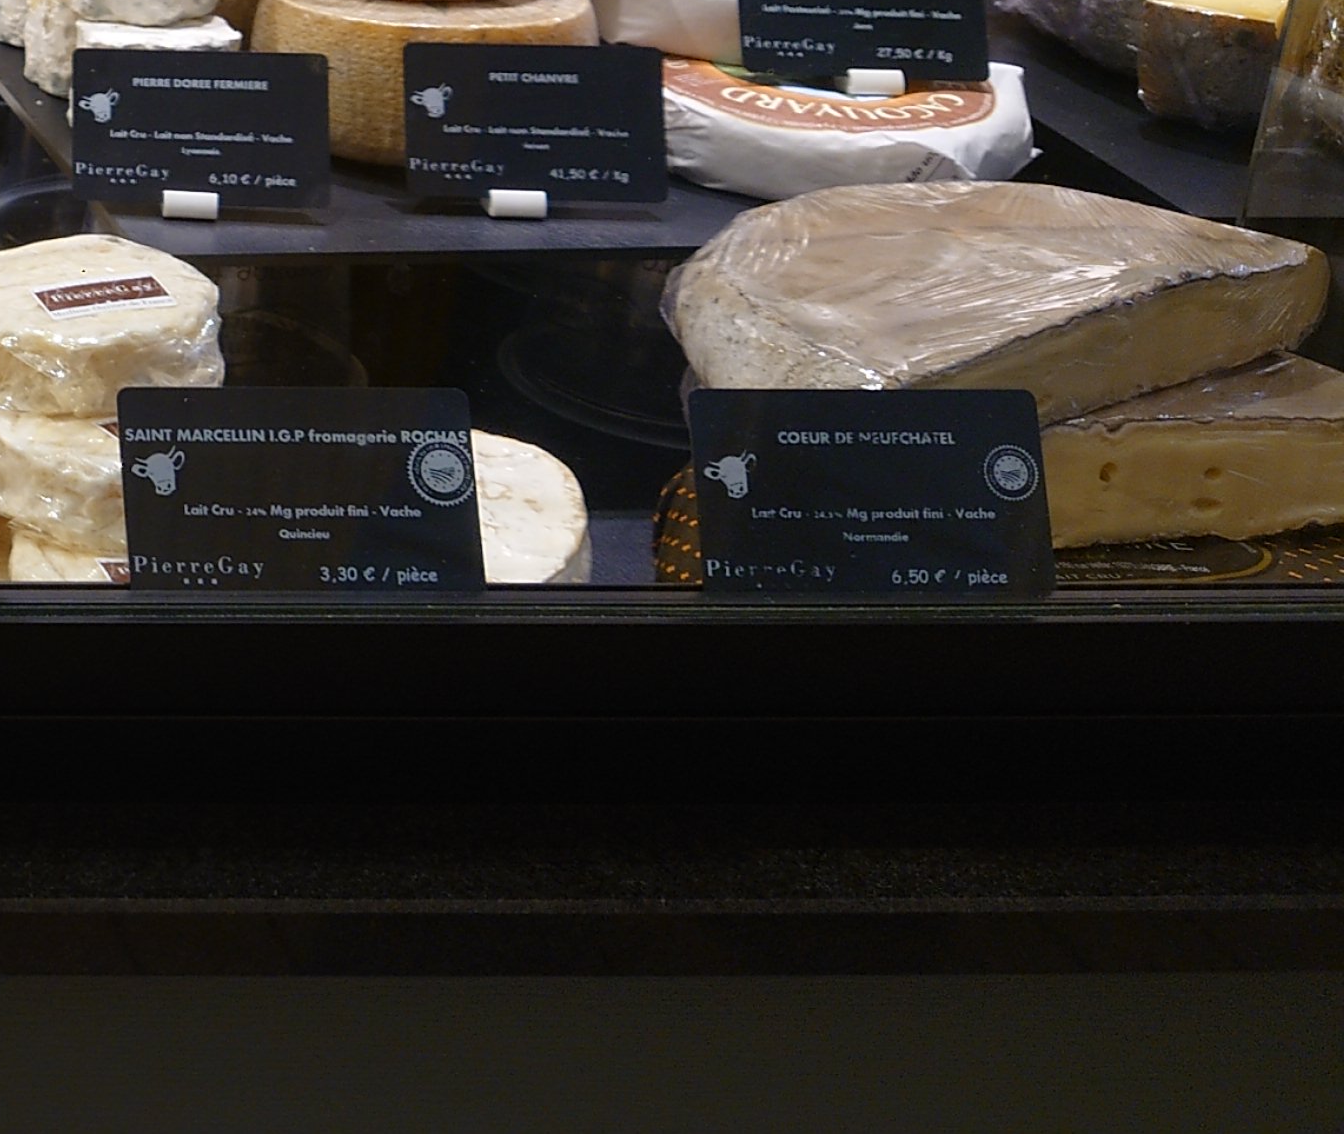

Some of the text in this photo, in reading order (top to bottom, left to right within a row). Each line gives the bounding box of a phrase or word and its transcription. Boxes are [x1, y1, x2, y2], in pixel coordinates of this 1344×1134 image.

[743, 36, 835, 54] PierreGay
[133, 78, 267, 90] PIERRE DOREE FERMIERE
[490, 73, 578, 83] PETIT CHANVRE
[721, 87, 964, 122] CACOUYARD
[75, 163, 169, 179] PierreGay
[409, 158, 504, 175] PierreGay
[265, 175, 296, 187] pièce
[125, 428, 468, 446] SAINT MARCELLIN I.G.P fromagerie ROCHAS
[778, 432, 853, 444] COEUR DE
[184, 504, 421, 519] Lait Cru Mg produit fini Vache
[872, 507, 995, 521] produit fini Vache
[279, 529, 330, 539] Quincieu
[133, 556, 263, 578] PierreGay
[320, 566, 438, 585] 3,30 pièce
[968, 569, 1008, 586] pièce
